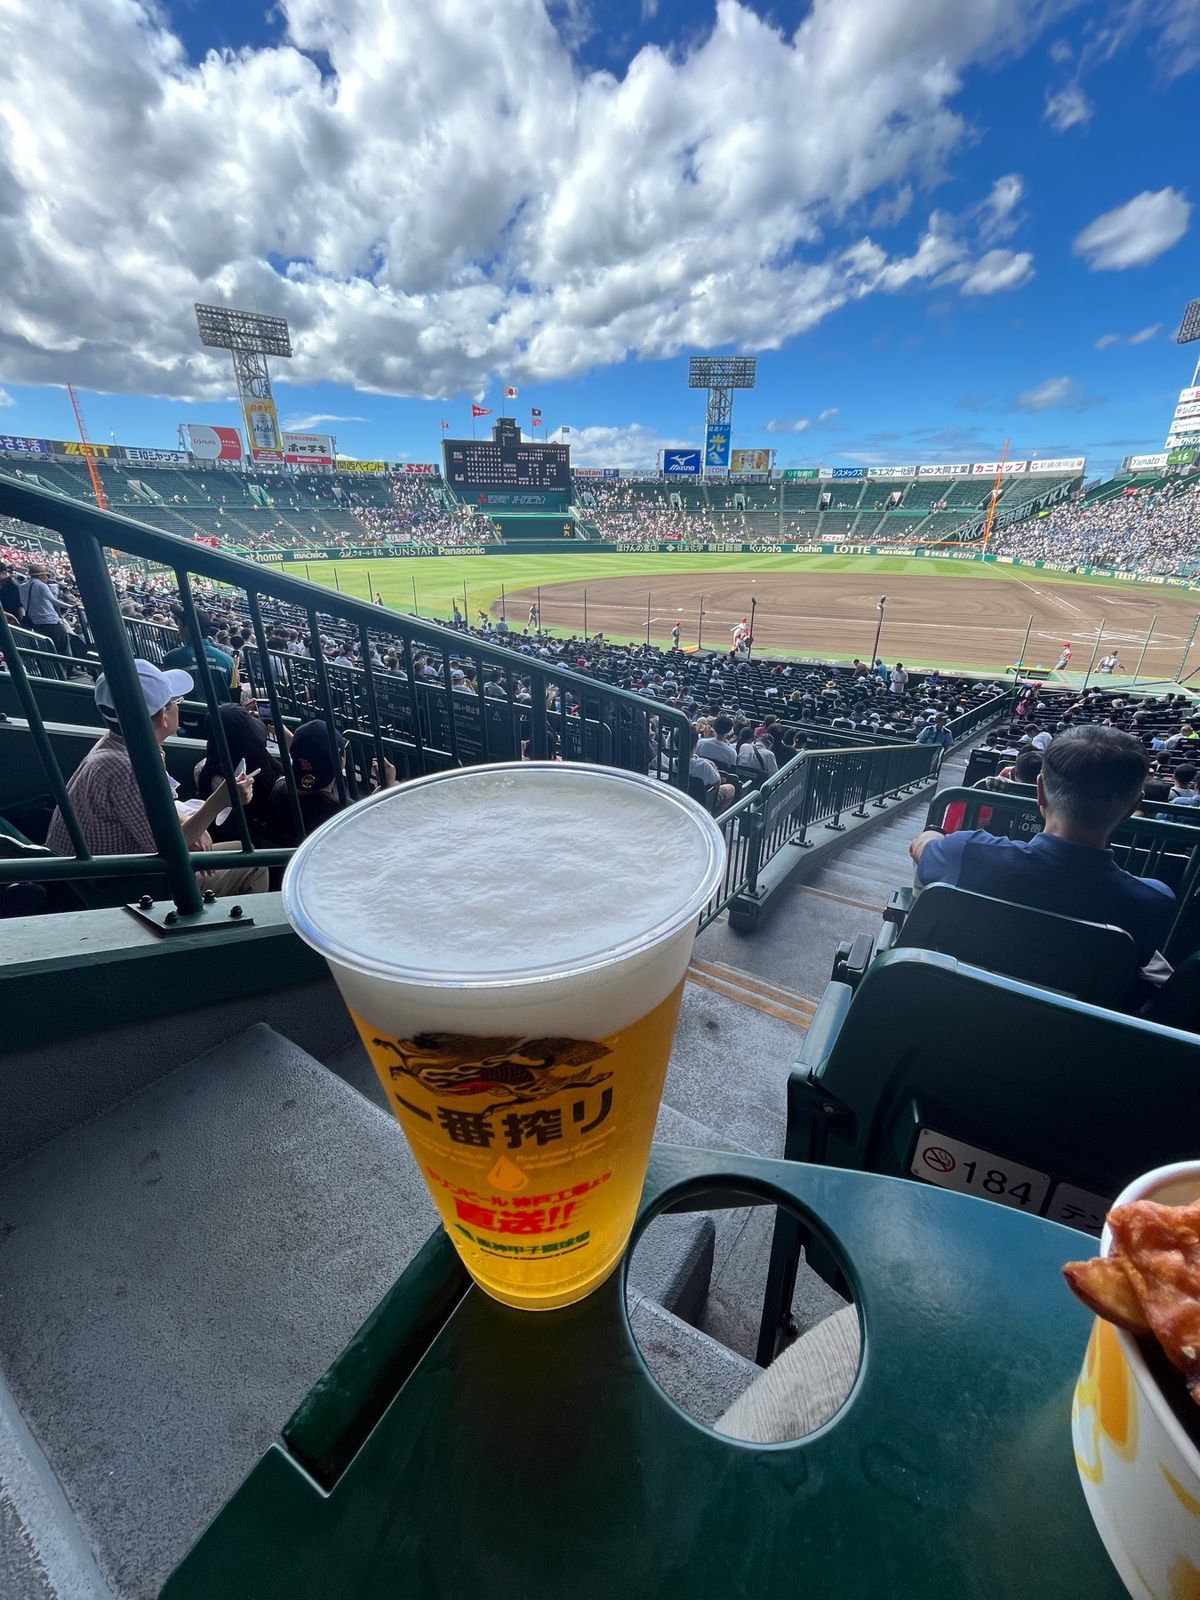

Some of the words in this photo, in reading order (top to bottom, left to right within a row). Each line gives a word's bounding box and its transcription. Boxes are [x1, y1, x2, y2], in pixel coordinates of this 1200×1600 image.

[288, 443, 327, 453] ホーチキ
[708, 434, 726, 452] 光
[405, 463, 433, 473] SSK
[879, 468, 915, 476] エスケー化研
[975, 462, 1024, 473] カニトップ
[833, 469, 864, 477] シスメックス
[389, 546, 434, 557] SUNSTAR
[438, 546, 486, 556] Panasonic
[616, 544, 659, 552] ほけんの窓口
[750, 544, 782, 553] Kubota
[793, 544, 823, 553] Joshin
[833, 545, 871, 555] LOTTE
[256, 551, 283, 562] home
[395, 1087, 613, 1149] 一番搾り
[963, 1161, 1033, 1206] 184
